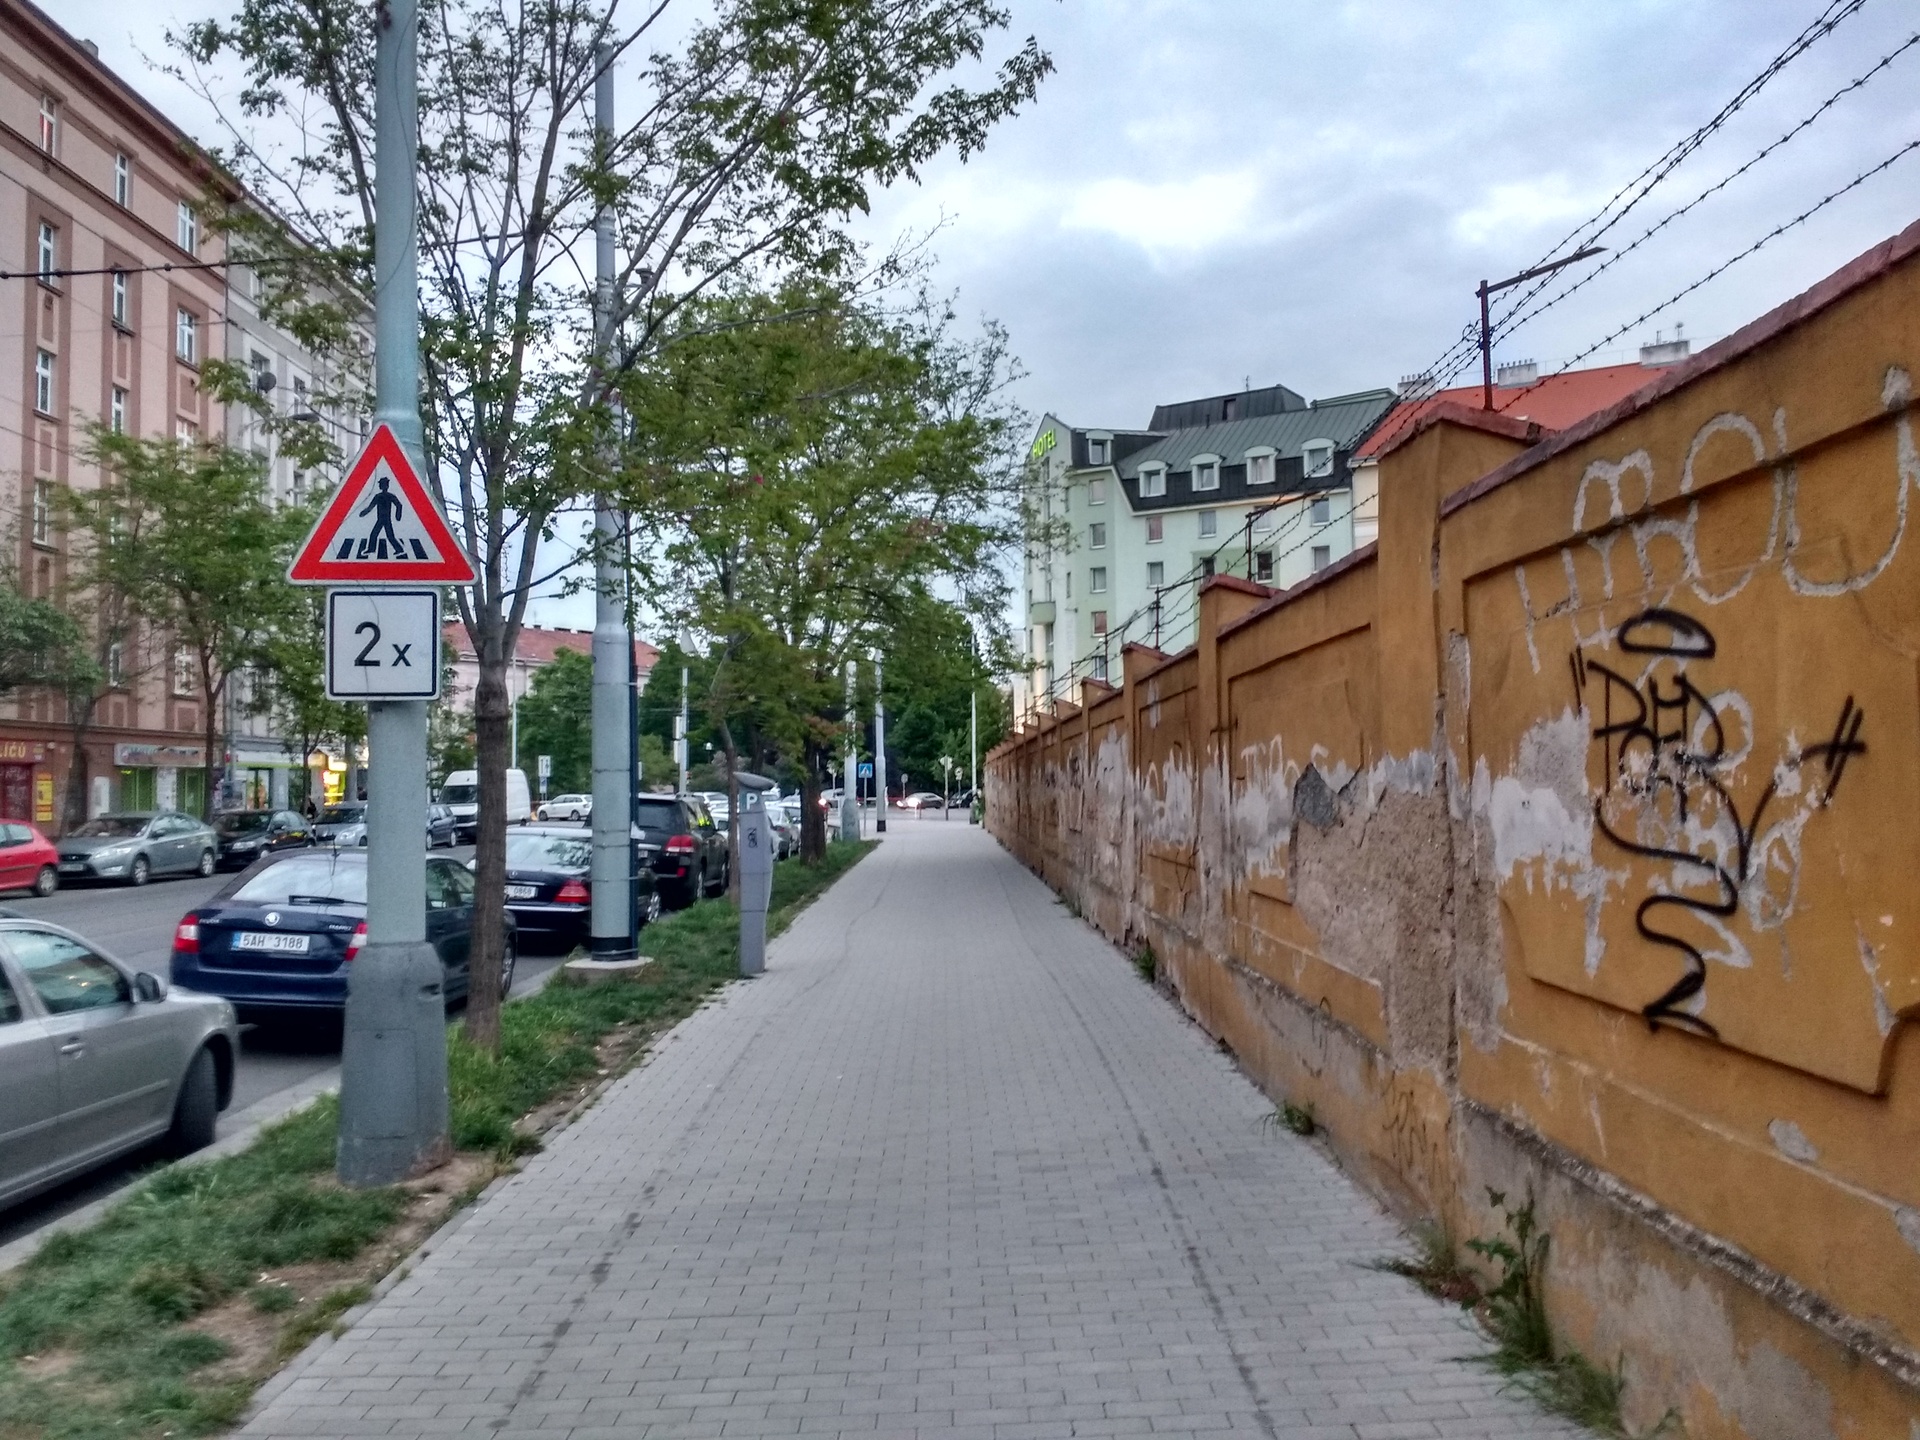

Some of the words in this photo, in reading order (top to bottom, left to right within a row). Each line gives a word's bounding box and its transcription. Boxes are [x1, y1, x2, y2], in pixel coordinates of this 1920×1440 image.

[1032, 428, 1056, 460] HOTEL
[746, 792, 758, 810] P
[243, 934, 265, 947] 5AH
[273, 936, 303, 949] 3188
